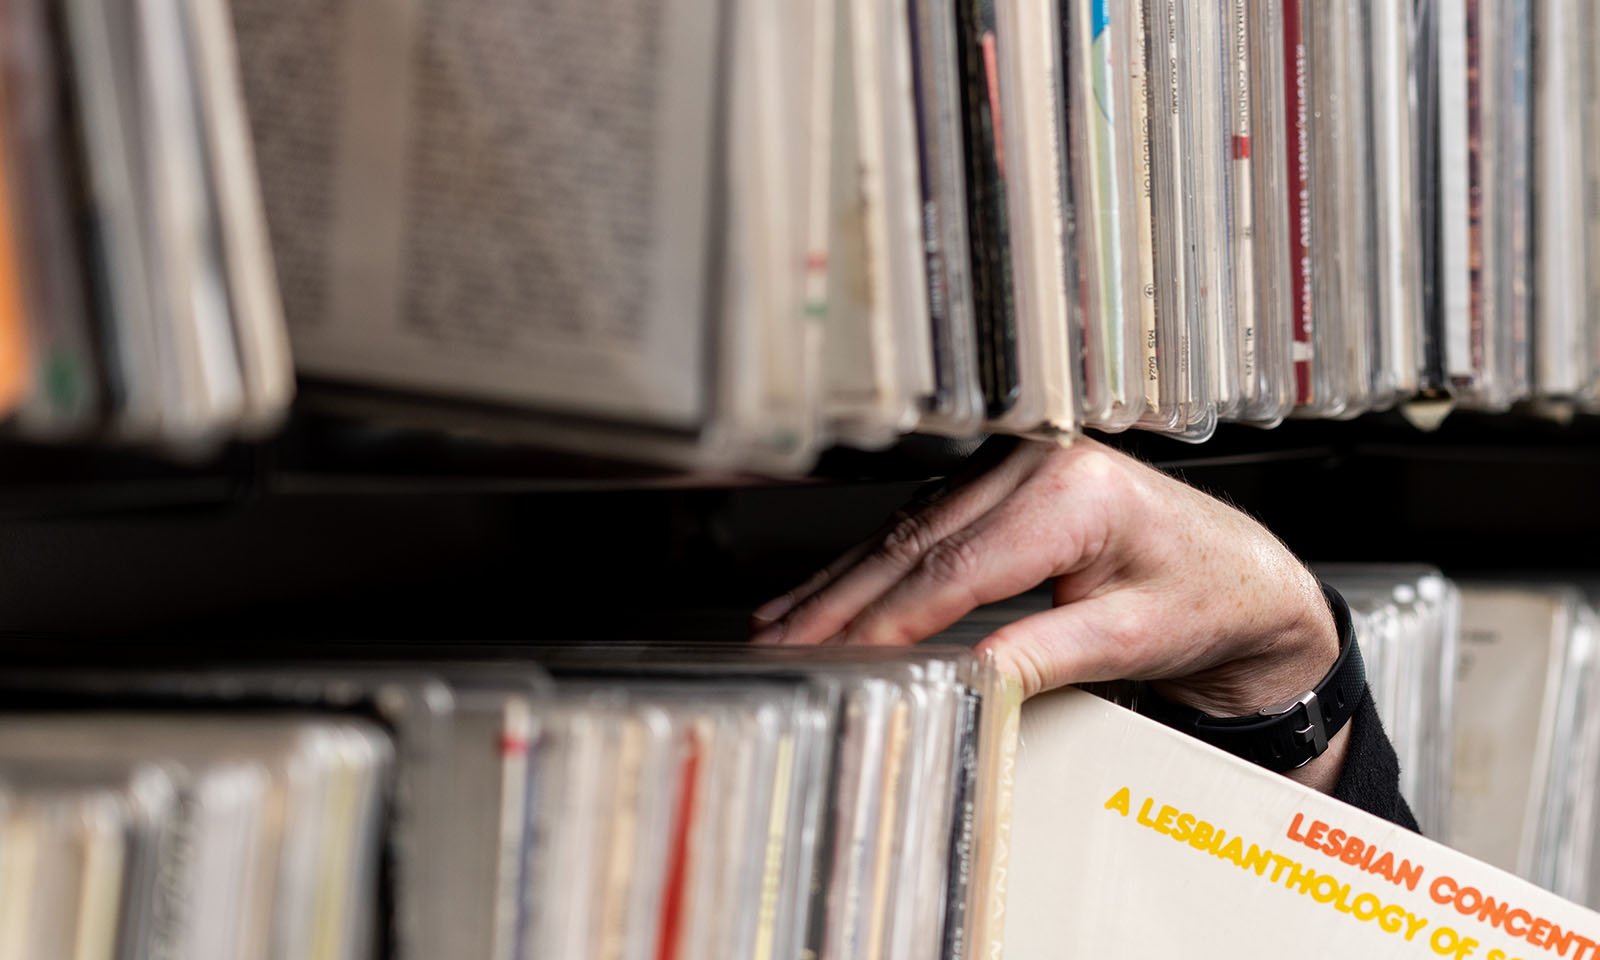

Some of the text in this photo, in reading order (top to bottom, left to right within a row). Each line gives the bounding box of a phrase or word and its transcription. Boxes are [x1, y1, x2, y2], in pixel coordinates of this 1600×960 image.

[1103, 786, 1131, 817] A
[1136, 796, 1429, 942] LESBIANTHOLOGY
[1286, 812, 1425, 892] LESBIAN
